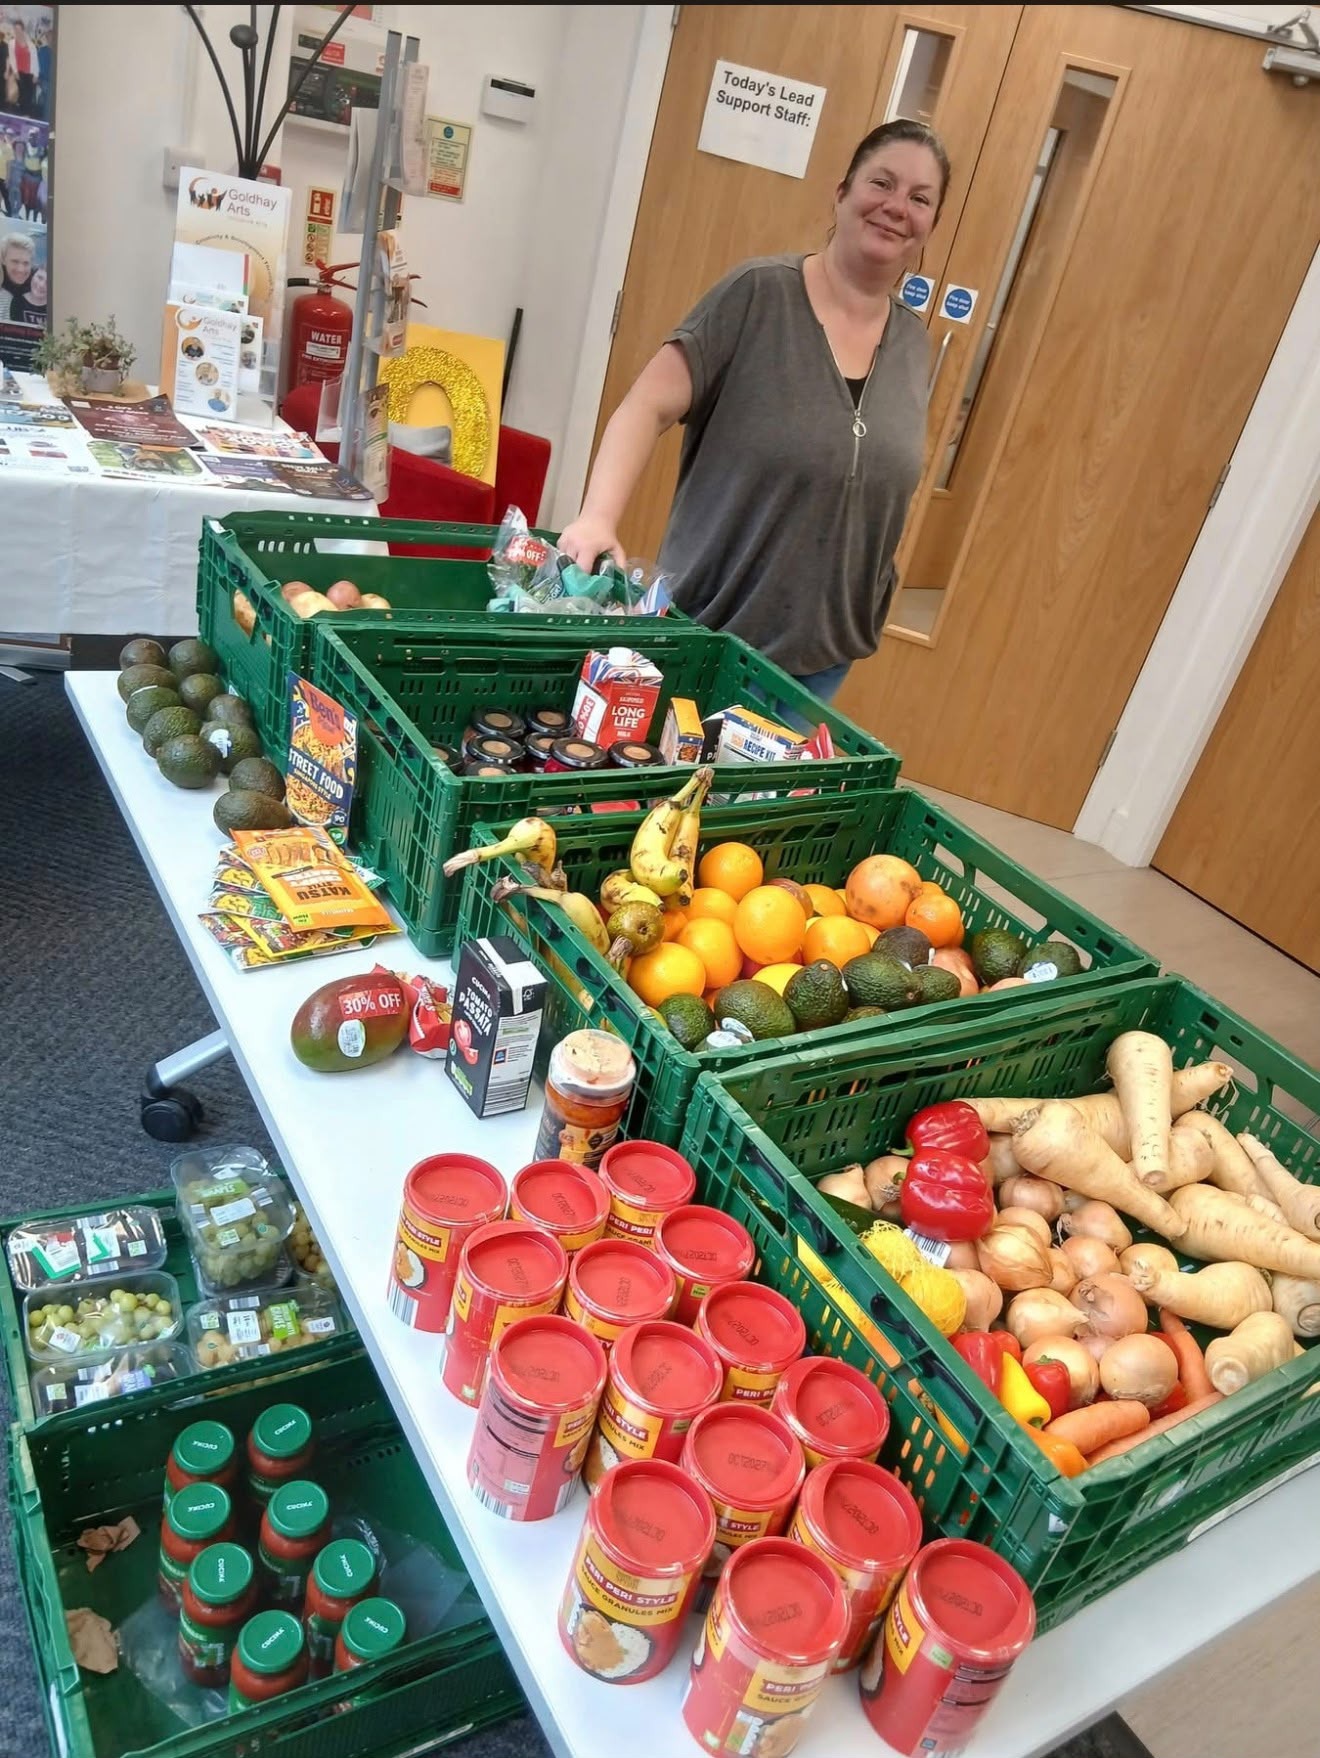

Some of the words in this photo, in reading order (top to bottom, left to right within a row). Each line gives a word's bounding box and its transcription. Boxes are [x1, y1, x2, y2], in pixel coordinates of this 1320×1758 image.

[723, 70, 776, 97] Today's
[779, 86, 815, 107] Lead
[715, 89, 772, 117] Support
[774, 105, 811, 127] Staff:
[228, 188, 277, 211] Goldhay
[227, 202, 250, 217] Arts
[202, 316, 238, 332] Goldhay
[202, 326, 220, 336] Arts
[311, 330, 342, 345] WATER
[526, 550, 541, 562] OFF
[308, 690, 341, 731] Ben's
[611, 705, 646, 718] LONG
[613, 717, 639, 728] LIFE
[743, 739, 766, 758] RECIPE
[319, 771, 344, 799] FOOD
[296, 886, 352, 901] KATSU
[343, 991, 376, 1015] 30%
[378, 993, 401, 1008] OFF
[466, 987, 493, 1017] TOMATO
[458, 991, 493, 1036] PASSATA
[609, 1215, 628, 1230] PERI
[630, 1225, 654, 1235] PERI
[736, 1388, 760, 1398] PERI
[615, 1416, 646, 1439] STYLE
[192, 1440, 219, 1450] CUCINA
[629, 1440, 645, 1451] MIX
[727, 1452, 768, 1470] OCT2027
[187, 1502, 216, 1513] CUCINA
[730, 1522, 761, 1532] STYLE
[585, 1555, 605, 1587] PERI
[606, 1580, 634, 1601] PERI
[637, 1593, 677, 1606] STYLE
[580, 1565, 600, 1594] SAUCE
[601, 1593, 654, 1617] GRANULES
[656, 1606, 674, 1616] MIX
[365, 1615, 389, 1635] CUCINA
[261, 1628, 286, 1649] CUCINA
[765, 1683, 796, 1694] PERI
[757, 1693, 790, 1704] SAUCE
